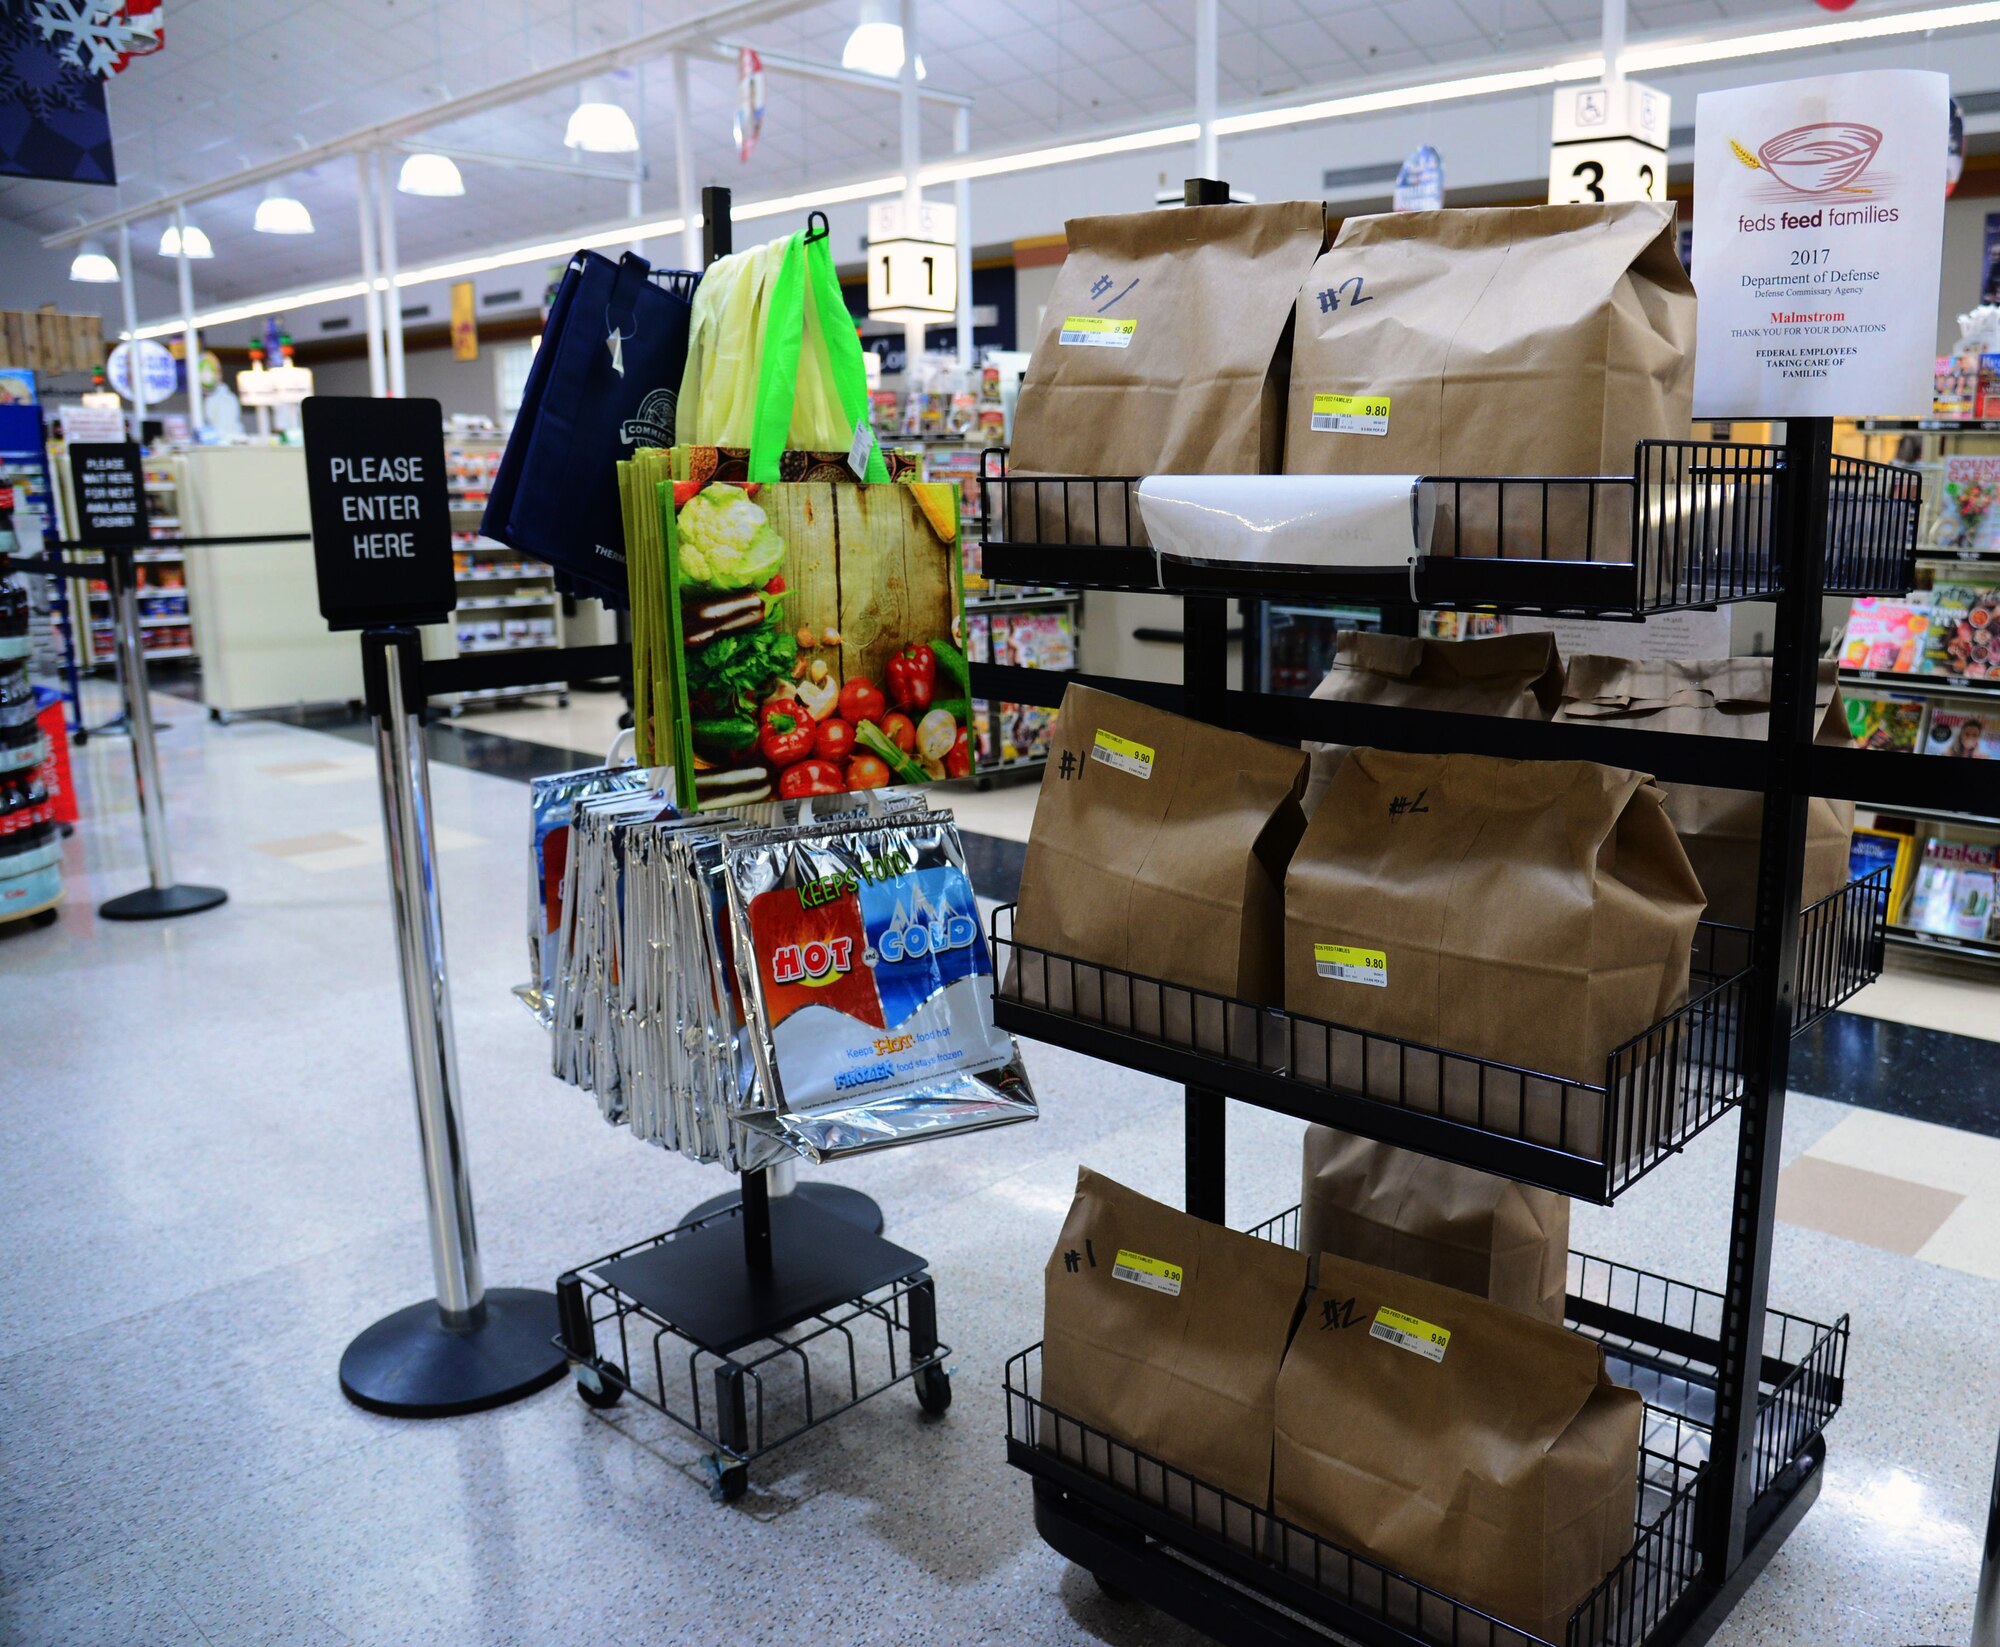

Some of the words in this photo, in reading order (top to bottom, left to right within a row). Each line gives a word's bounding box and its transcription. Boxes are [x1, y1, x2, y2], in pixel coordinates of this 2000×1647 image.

[1570, 161, 1605, 203] 3
[1738, 213, 1776, 233] feds
[1780, 209, 1823, 230] feed
[1828, 205, 1899, 227] families
[1790, 249, 1830, 266] 2017
[881, 255, 890, 296] 1
[921, 256, 934, 296] 1
[1741, 273, 1810, 290] Department
[1813, 271, 1828, 283] of
[1830, 269, 1880, 283] Defense
[1316, 277, 1374, 314] #2
[1754, 289, 1785, 298] Defense
[1786, 287, 1833, 297] Commissary
[1834, 286, 1863, 296] Agency
[1770, 311, 1845, 324] Malmstrom
[1114, 326, 1133, 334] 9.90
[1731, 328, 1760, 338] THANK
[1762, 327, 1782, 336] YOU
[1784, 327, 1802, 335] FOR
[1803, 326, 1830, 335] YOUR
[1831, 324, 1887, 334] DONATIONS
[1756, 348, 1798, 358] FEDERAL
[1800, 347, 1858, 356] EMPLOYEES
[1766, 358, 1802, 368] TAKING
[1804, 358, 1830, 367] CARE
[1832, 357, 1845, 366] OF
[1782, 369, 1828, 378] FAMILIES
[1365, 405, 1387, 416] 9.80
[86, 458, 125, 470] PLEASE
[330, 457, 424, 483] PLEASE
[342, 495, 420, 522] ENTER
[353, 532, 416, 559] HERE
[1059, 749, 1085, 781] #1
[1134, 751, 1150, 763] 9.90
[797, 868, 859, 909] KEEPS
[860, 851, 908, 886] FOOD
[773, 936, 853, 983] HOT
[865, 952, 877, 962] and
[879, 916, 978, 963] COLD
[1365, 957, 1384, 969] 9.80
[846, 1045, 874, 1060] Keeps
[916, 1031, 936, 1042] food
[936, 1027, 951, 1038] hot
[833, 1060, 896, 1091] FROZEN
[896, 1061, 914, 1072] food
[915, 1055, 936, 1069] stays
[937, 1049, 963, 1063] frozen
[1064, 1239, 1097, 1273] #1
[1164, 1269, 1180, 1281] 9.90
[1319, 1297, 1367, 1331] #2
[1431, 1333, 1447, 1347] 9.80
